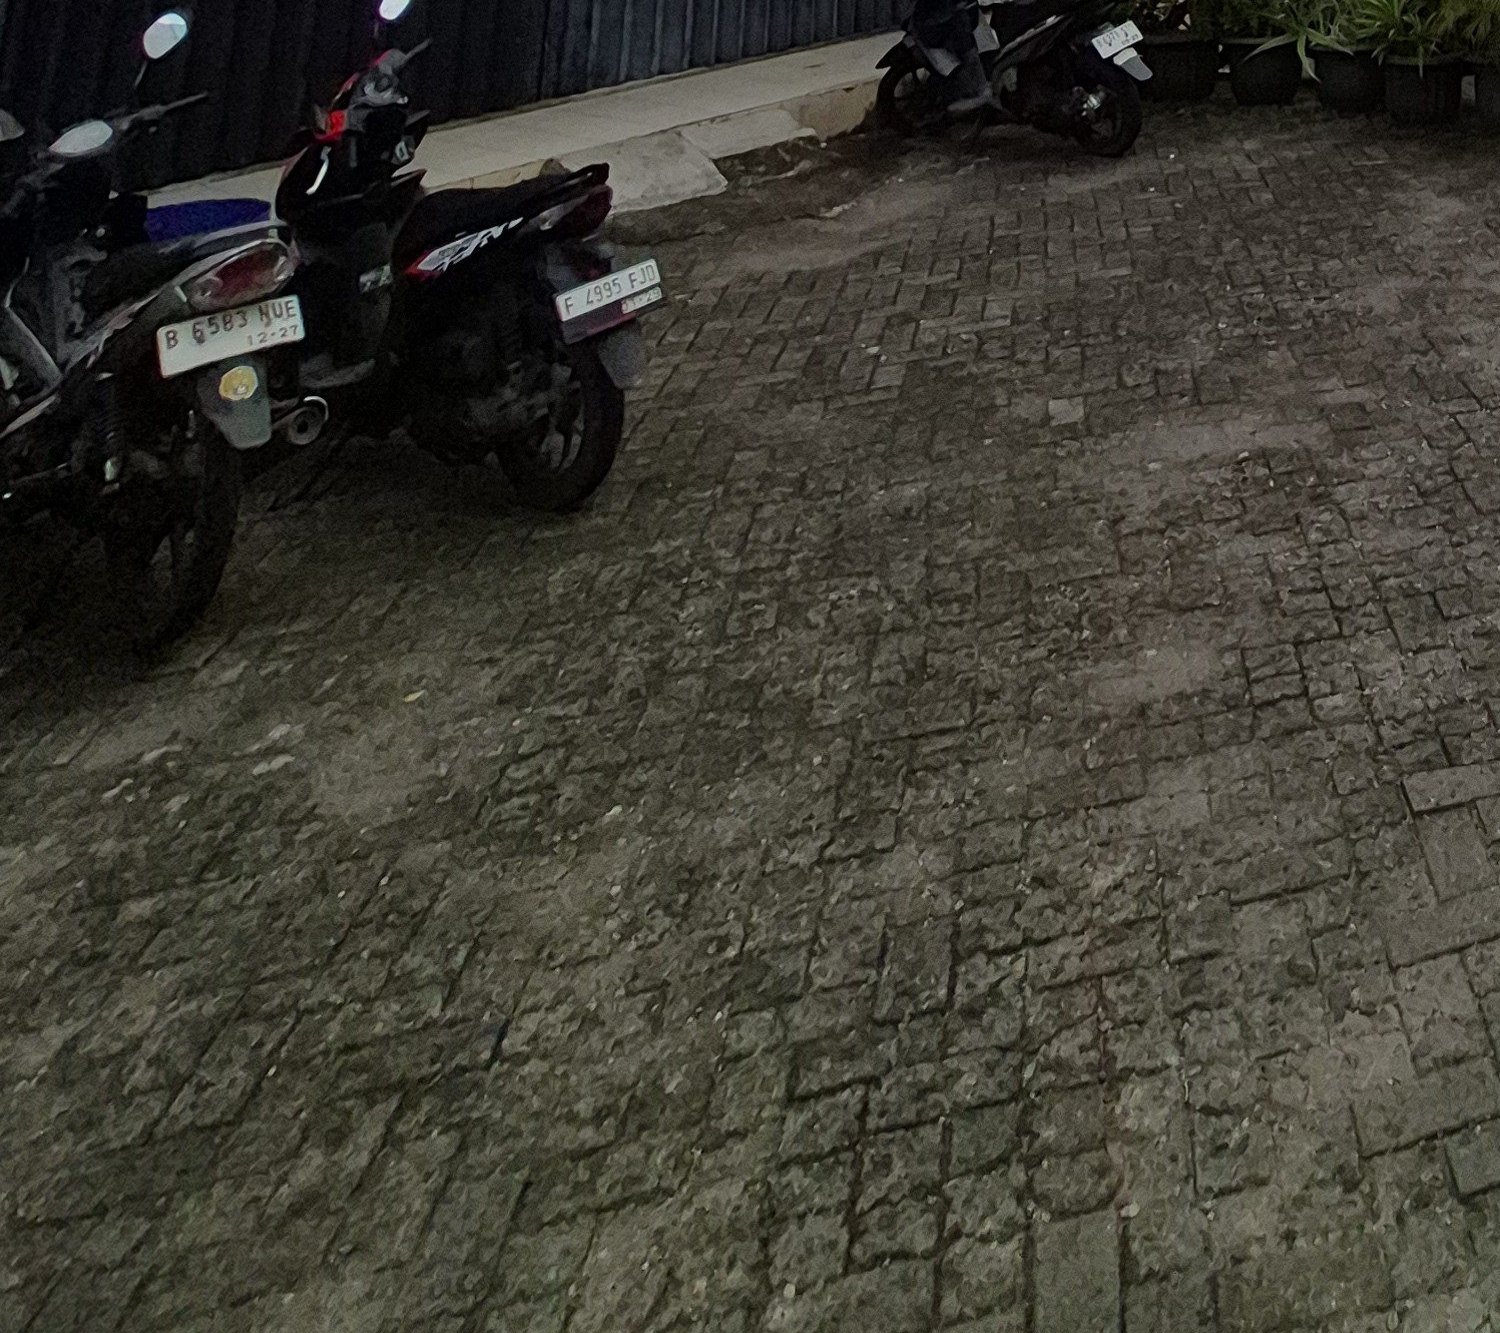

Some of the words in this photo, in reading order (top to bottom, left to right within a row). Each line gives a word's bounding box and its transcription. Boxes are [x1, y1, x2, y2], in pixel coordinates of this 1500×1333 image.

[564, 296, 574, 316] F
[586, 277, 623, 305] 4995
[628, 264, 657, 289] FJD
[165, 329, 179, 349] B
[192, 309, 248, 345] 6583
